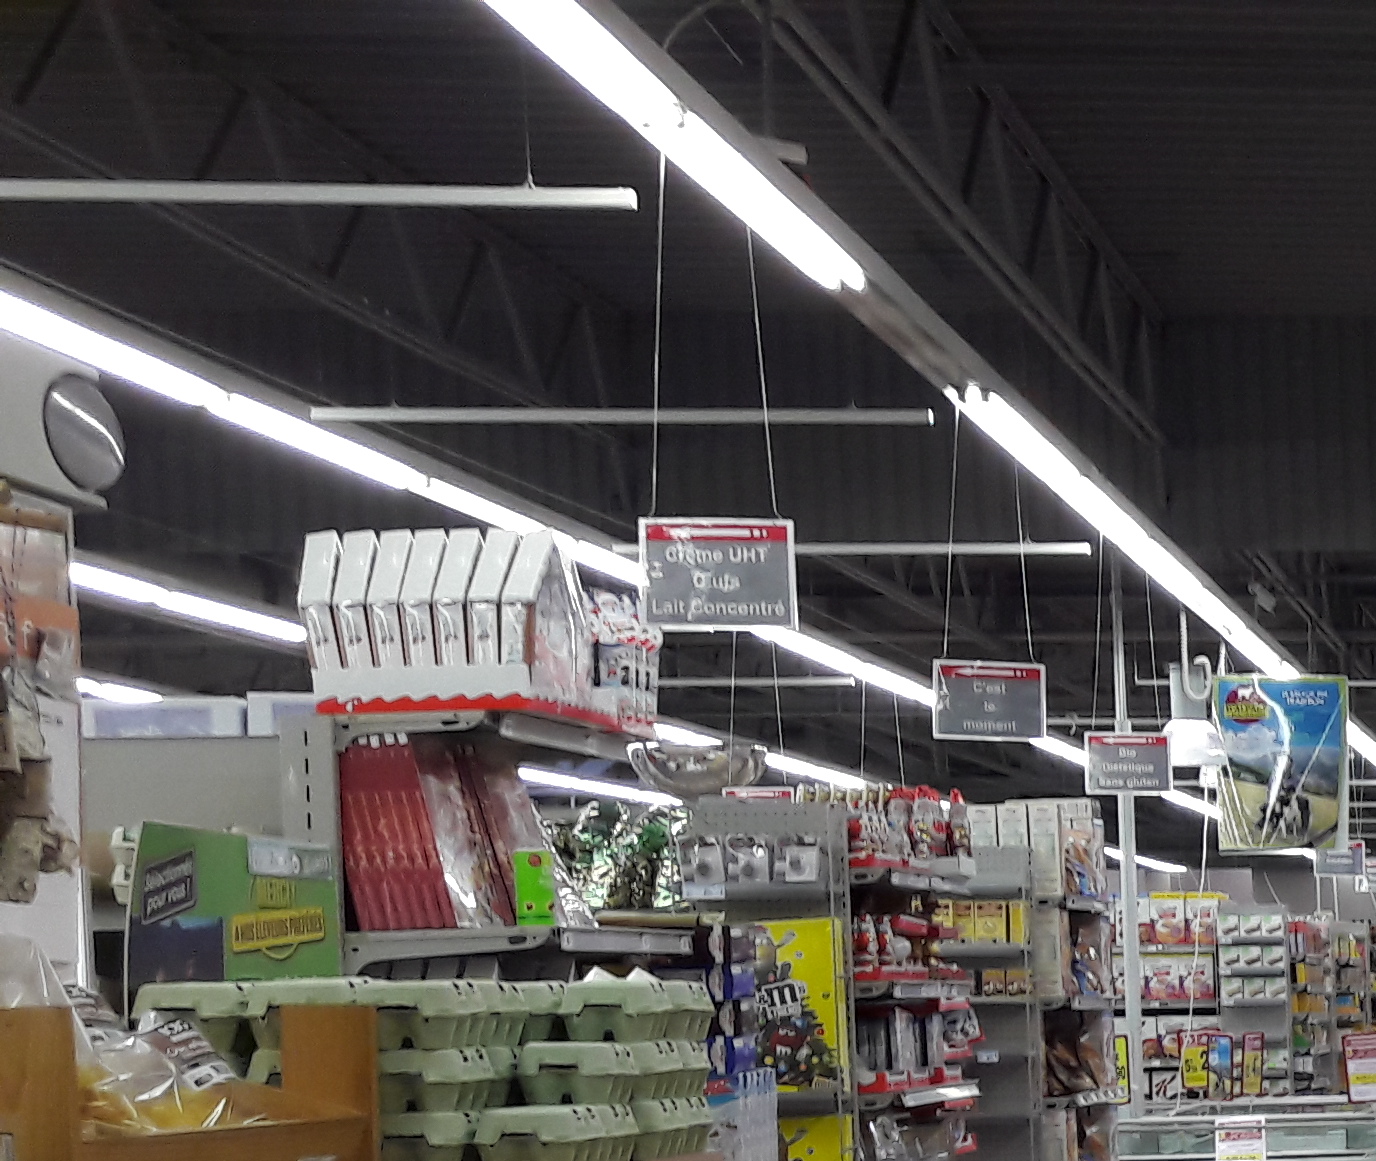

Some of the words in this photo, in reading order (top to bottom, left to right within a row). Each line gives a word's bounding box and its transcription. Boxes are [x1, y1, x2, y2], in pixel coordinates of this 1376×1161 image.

[728, 544, 768, 565] UHT
[652, 598, 685, 616] Lait
[962, 720, 1018, 733] moment
